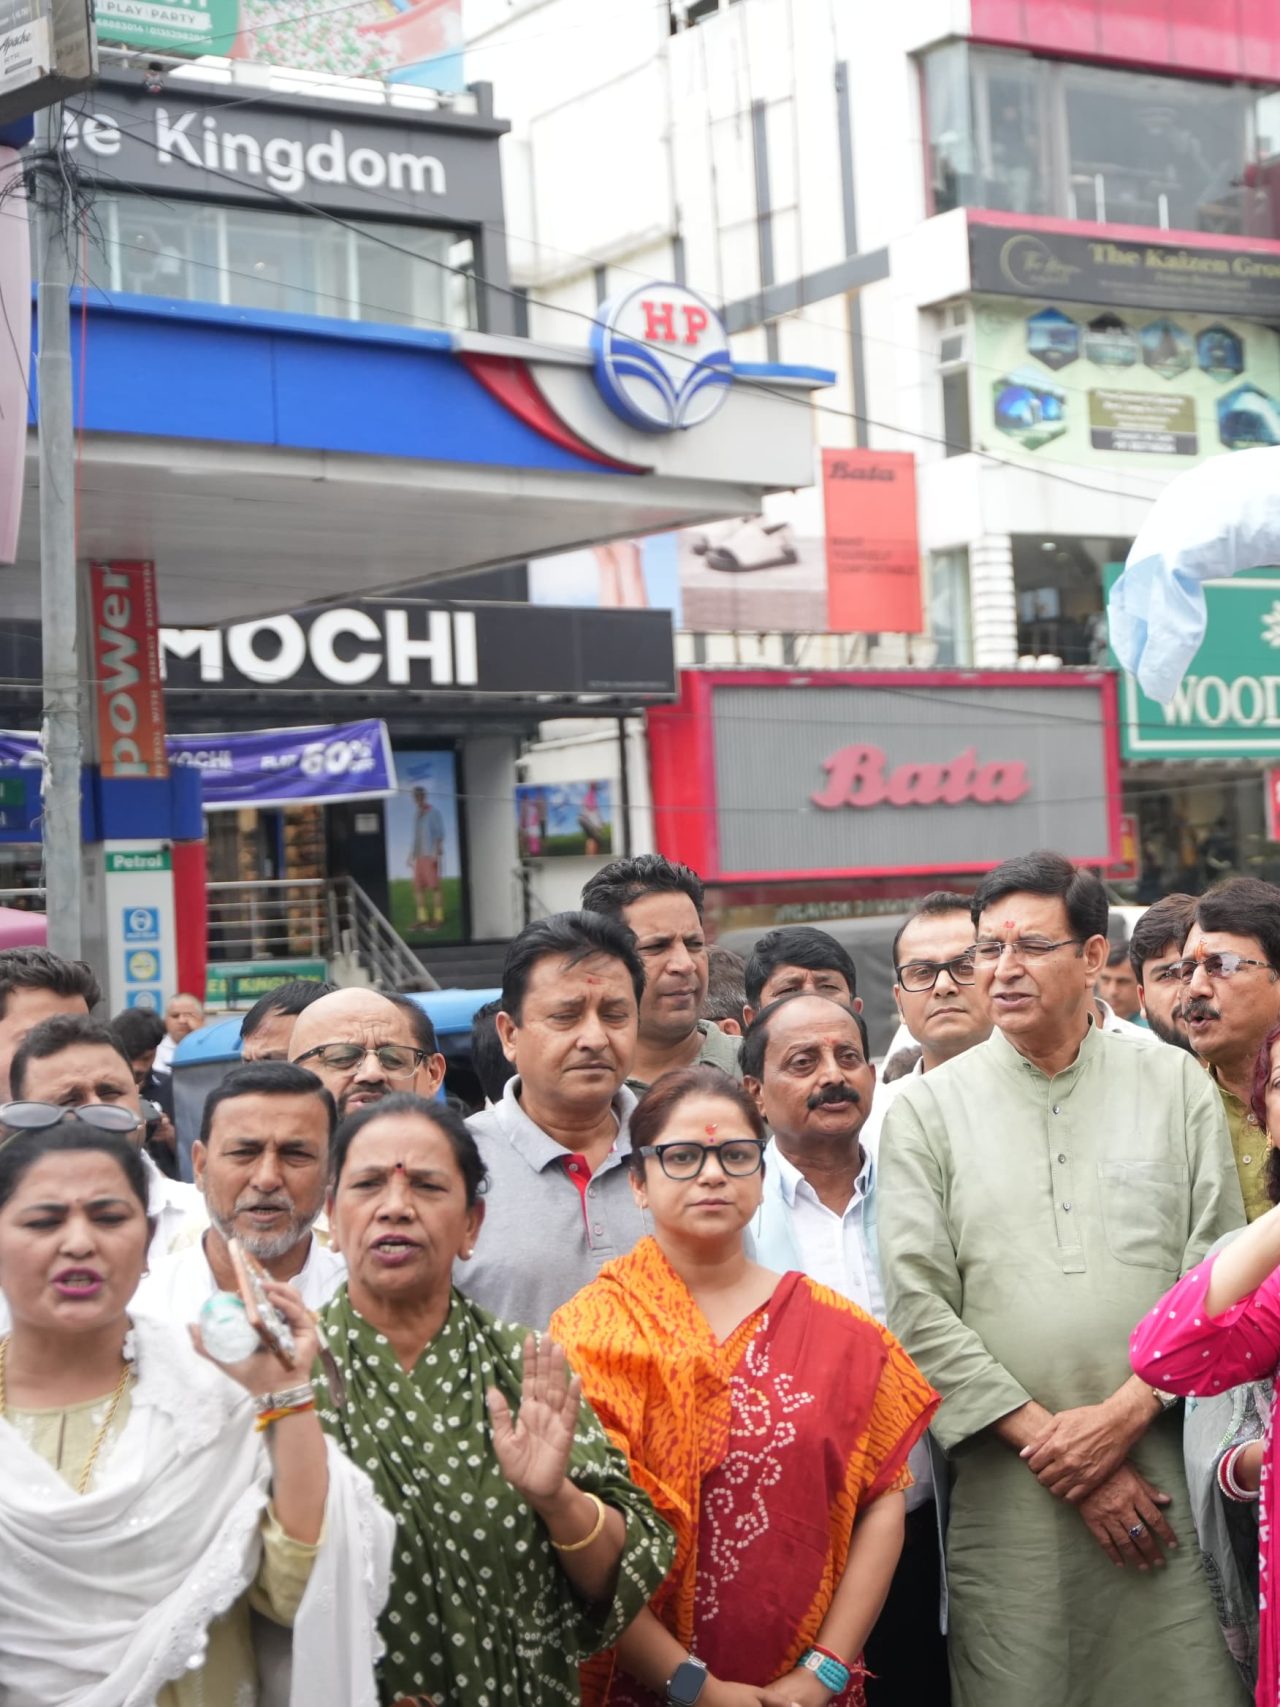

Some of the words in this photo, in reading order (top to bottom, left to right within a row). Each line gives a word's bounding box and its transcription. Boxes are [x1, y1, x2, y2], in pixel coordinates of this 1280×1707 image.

[106, 2, 142, 16] PLAY
[150, 8, 198, 25] PARTY
[155, 106, 448, 195] Kingdom
[1089, 243, 1141, 267] The
[1144, 247, 1231, 274] Kaizen
[641, 301, 709, 346] HP
[829, 461, 895, 482] Bata
[158, 607, 479, 685] MOCHI
[99, 567, 150, 777] power
[150, 689, 161, 723] WITH
[809, 743, 1032, 812] Bata
[113, 853, 163, 869] Petrol
